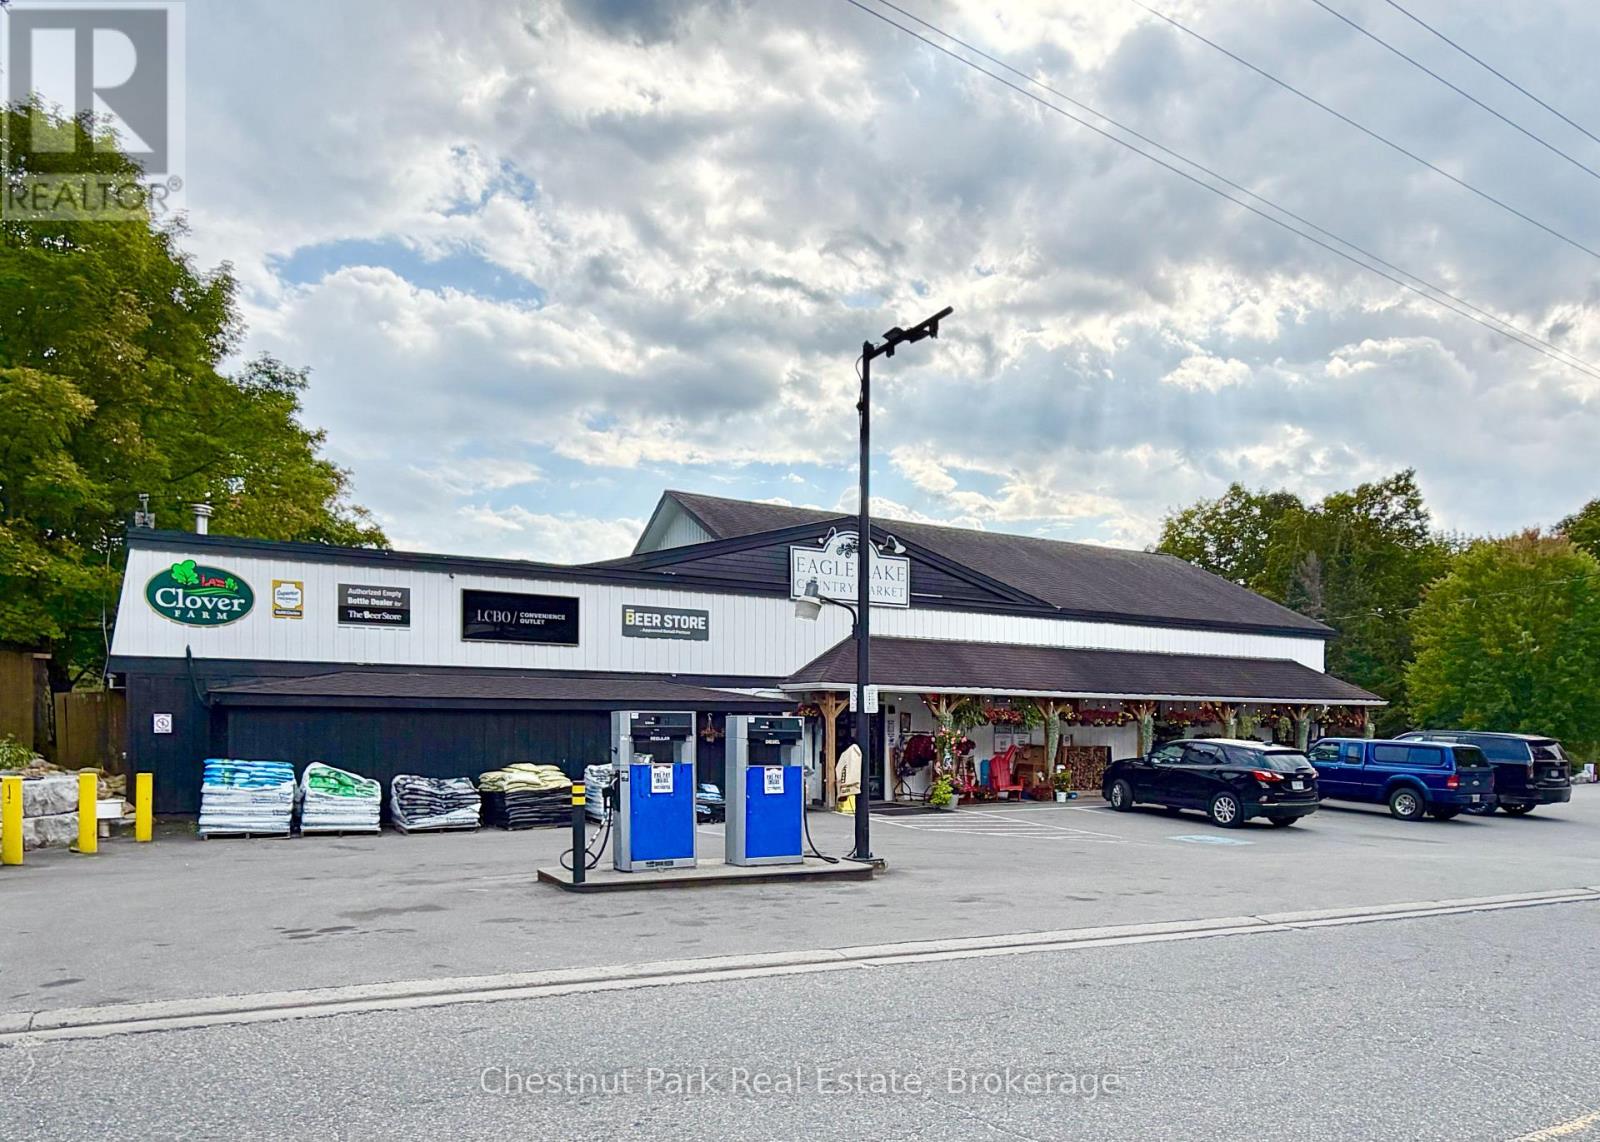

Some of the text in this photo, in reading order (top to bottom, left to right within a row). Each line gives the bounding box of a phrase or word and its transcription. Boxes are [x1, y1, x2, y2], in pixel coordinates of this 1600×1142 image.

[796, 556, 905, 582] EAGLE AKE
[347, 588, 402, 599] Authorized Empty
[796, 578, 905, 598] CNTRY RKET
[155, 587, 246, 611] Clover
[347, 597, 369, 605] Bottle
[370, 599, 393, 607] Dealer
[174, 609, 228, 620] FARM
[348, 610, 402, 621] The Beer Store
[477, 609, 511, 623] LCBO
[519, 611, 566, 620] CONVENIENCE
[625, 609, 706, 630] BEER STORE
